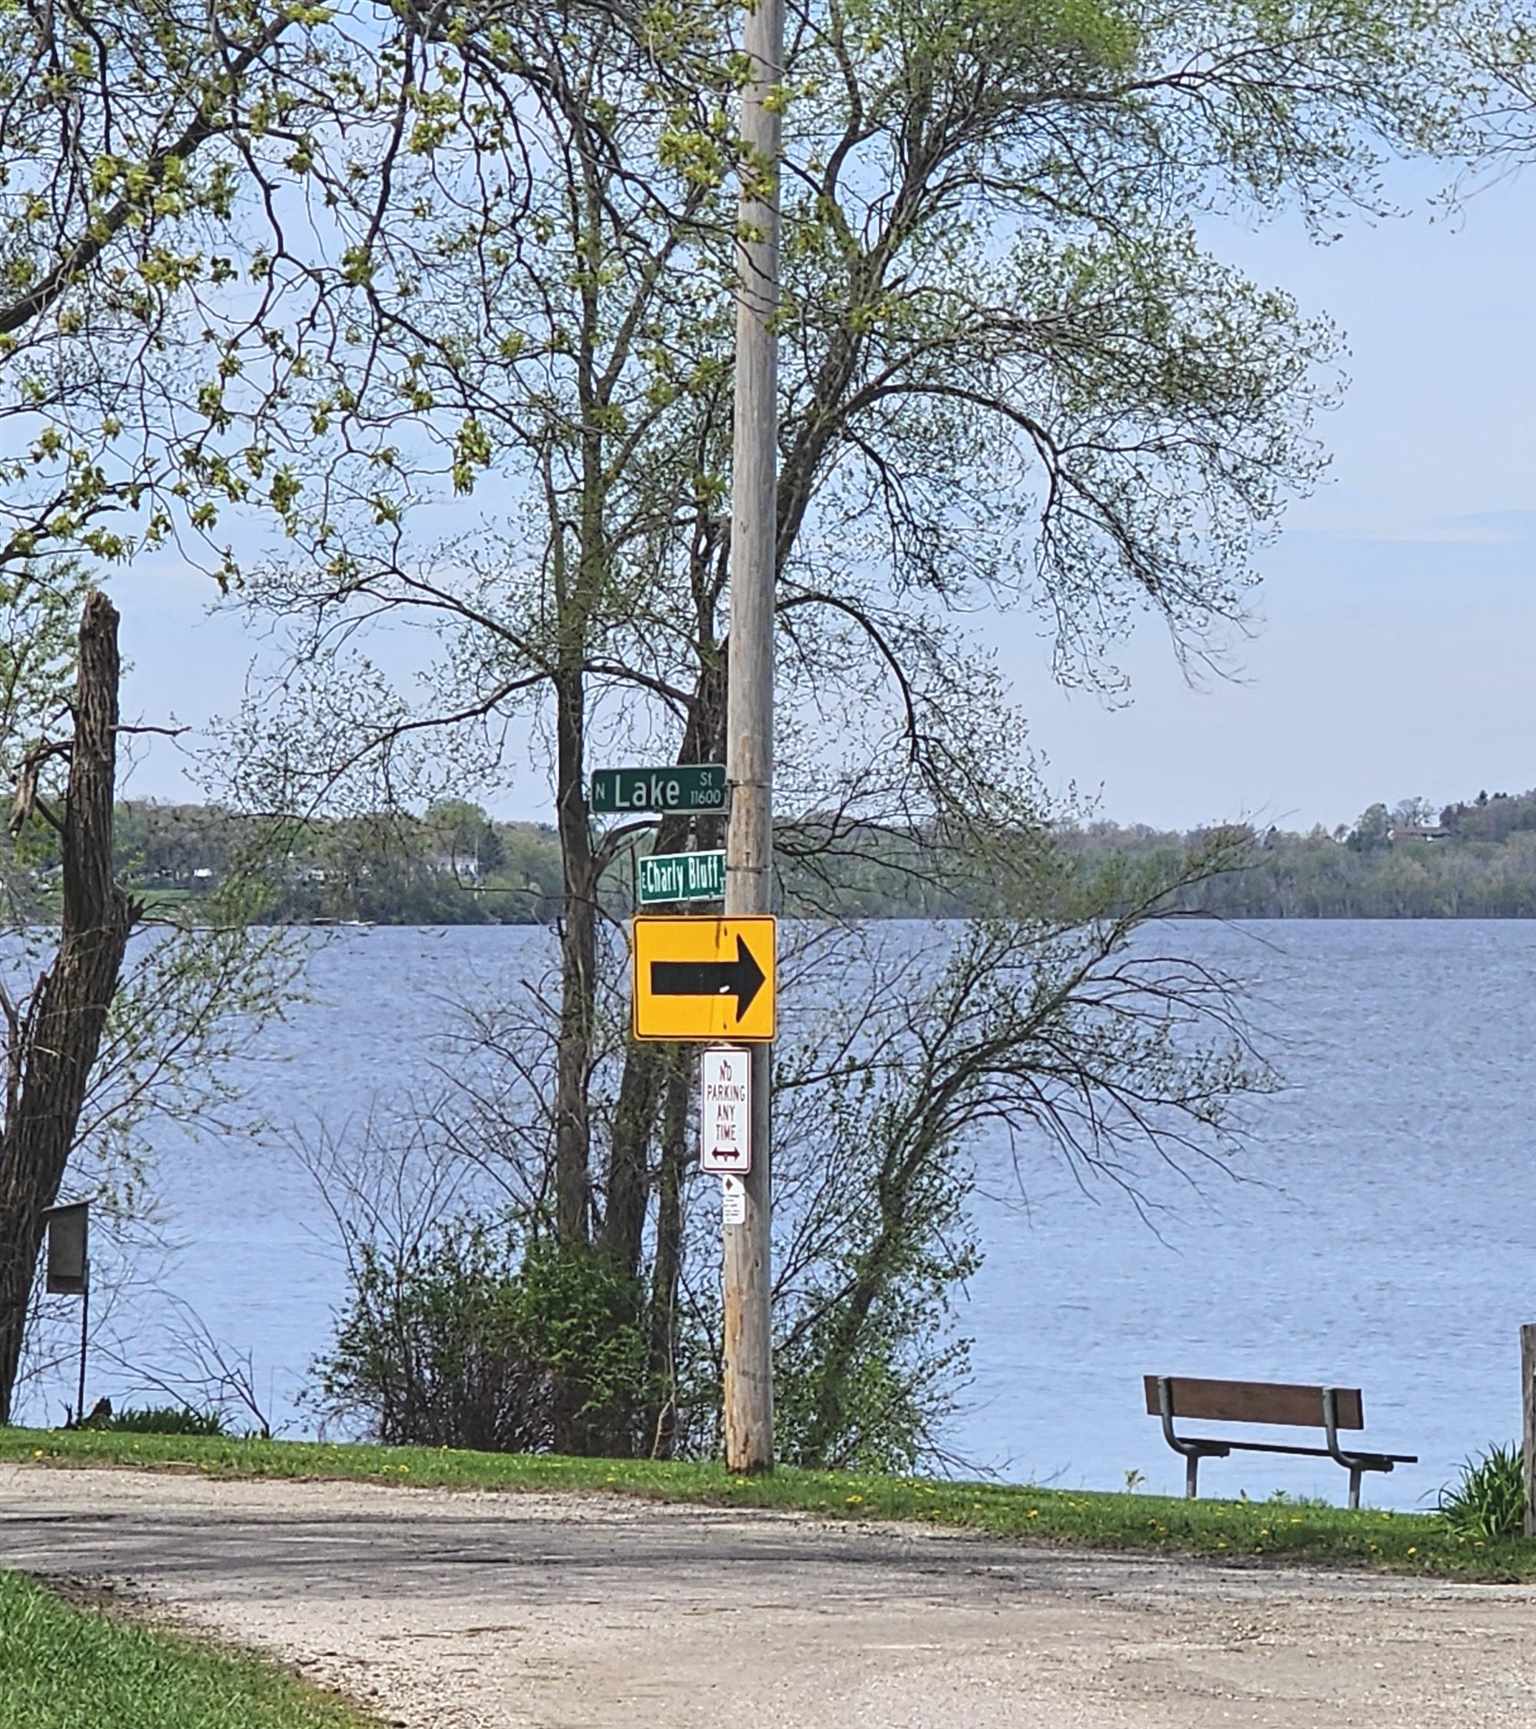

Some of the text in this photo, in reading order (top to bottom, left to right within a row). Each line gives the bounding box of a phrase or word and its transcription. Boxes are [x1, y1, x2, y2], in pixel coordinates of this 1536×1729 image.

[700, 772, 713, 787] St
[595, 774, 680, 808] N Lake
[690, 790, 721, 805] 11600
[647, 860, 684, 899] Charly
[688, 855, 718, 890] Bluff
[719, 1065, 732, 1081] NO
[707, 1085, 745, 1102] PARKING
[717, 1104, 735, 1121] ANY
[715, 1124, 737, 1141] TIME
